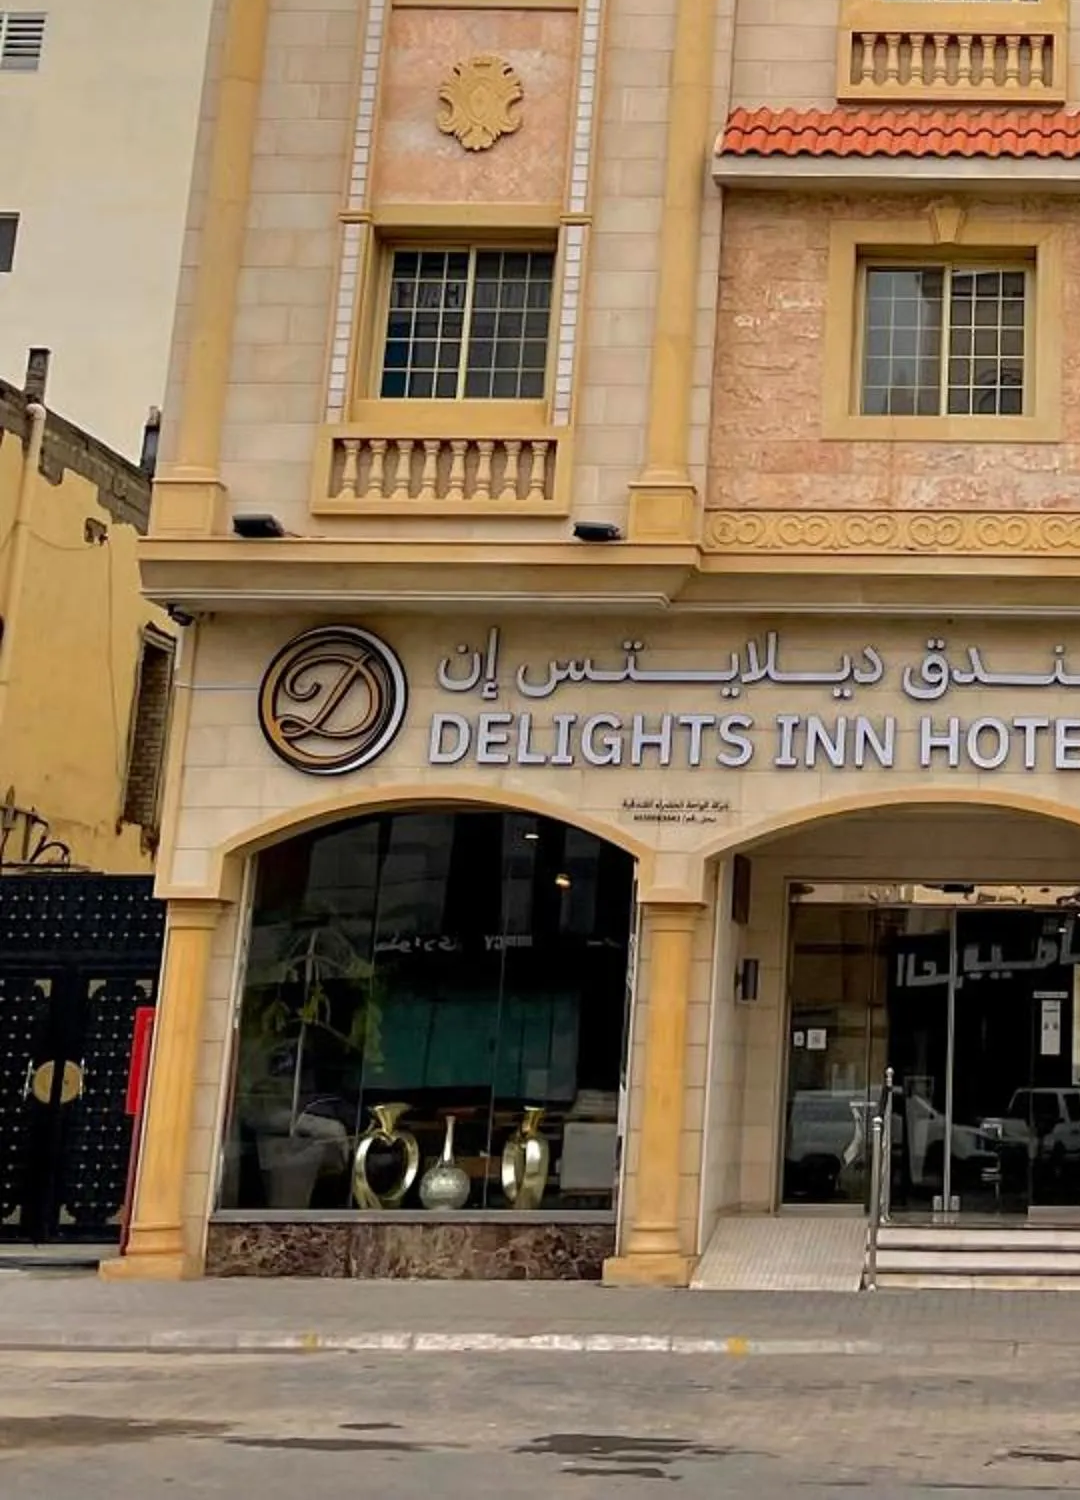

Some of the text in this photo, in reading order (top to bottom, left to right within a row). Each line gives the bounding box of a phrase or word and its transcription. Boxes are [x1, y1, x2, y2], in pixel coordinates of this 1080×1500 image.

[438, 625, 500, 700] إن
[516, 631, 884, 698] ديلايتس
[429, 711, 754, 767] DELIGHTS
[774, 714, 896, 768] INN
